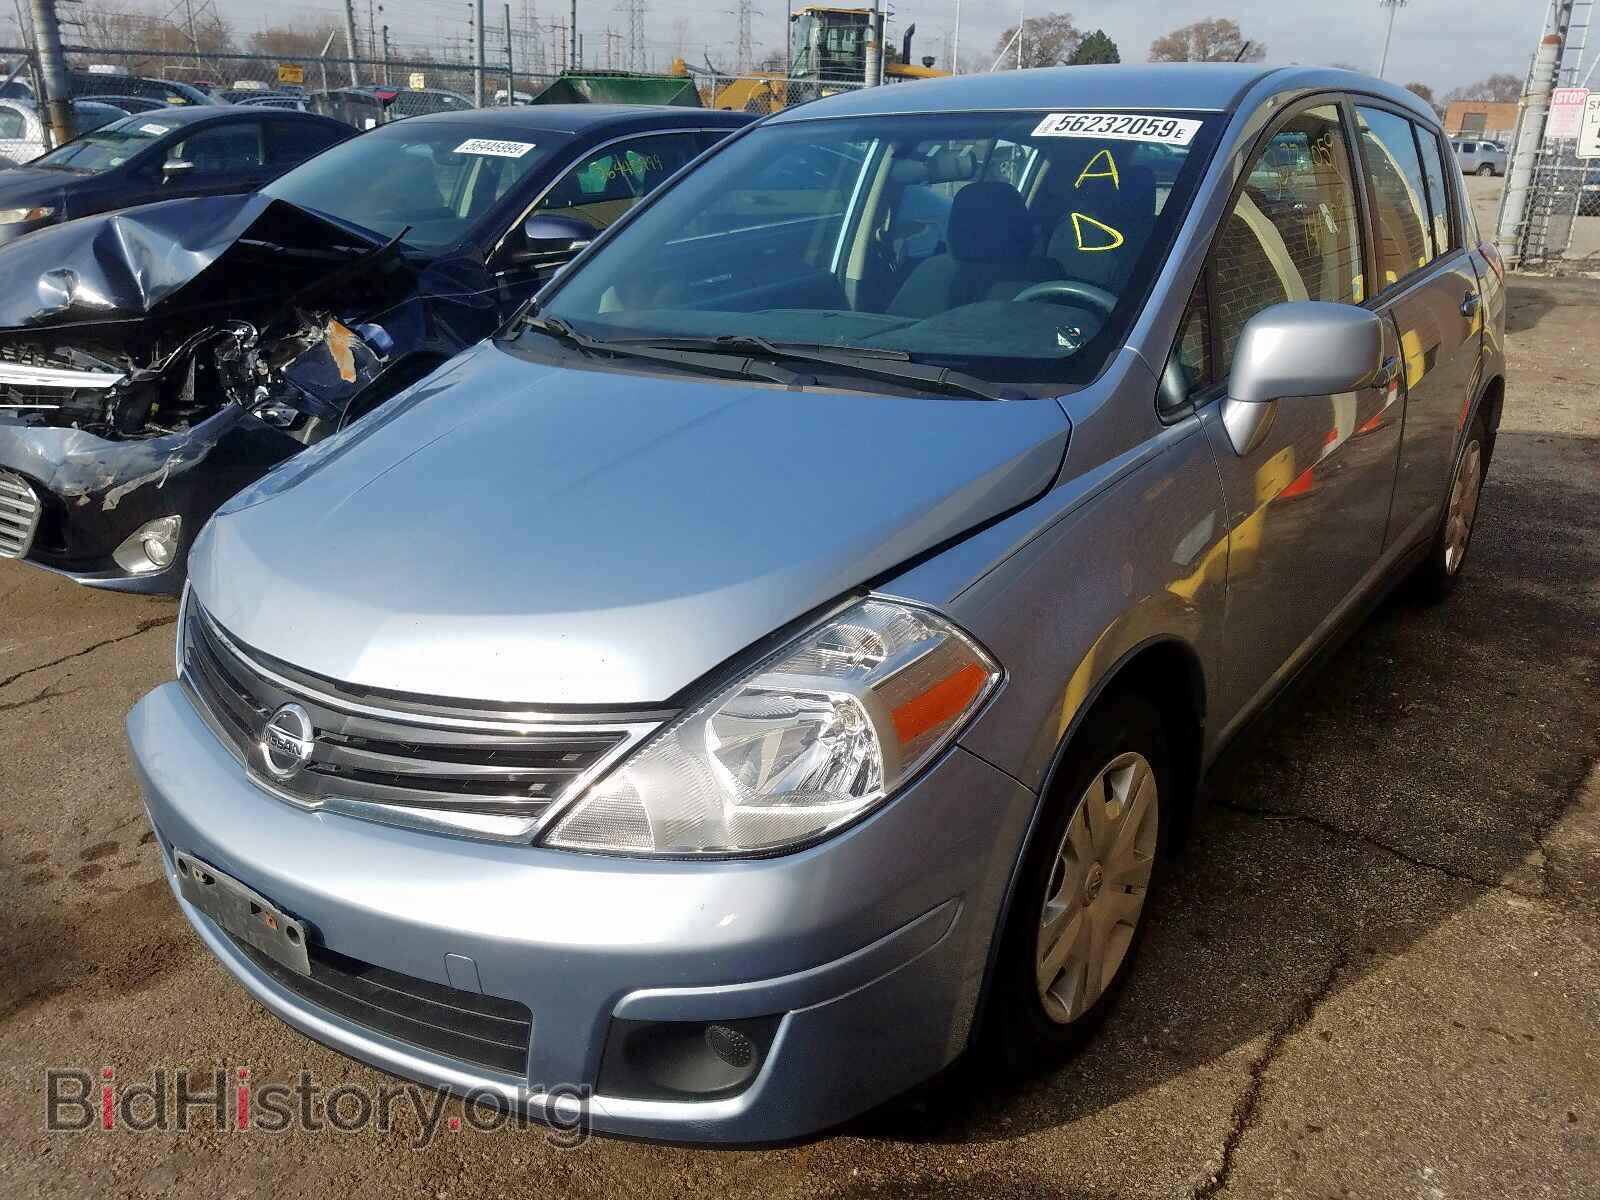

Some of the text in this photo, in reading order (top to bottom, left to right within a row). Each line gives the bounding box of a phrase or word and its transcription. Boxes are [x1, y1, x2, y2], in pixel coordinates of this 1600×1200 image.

[1555, 91, 1585, 105] STOP
[1074, 149, 1120, 191] A
[1071, 212, 1124, 251] D
